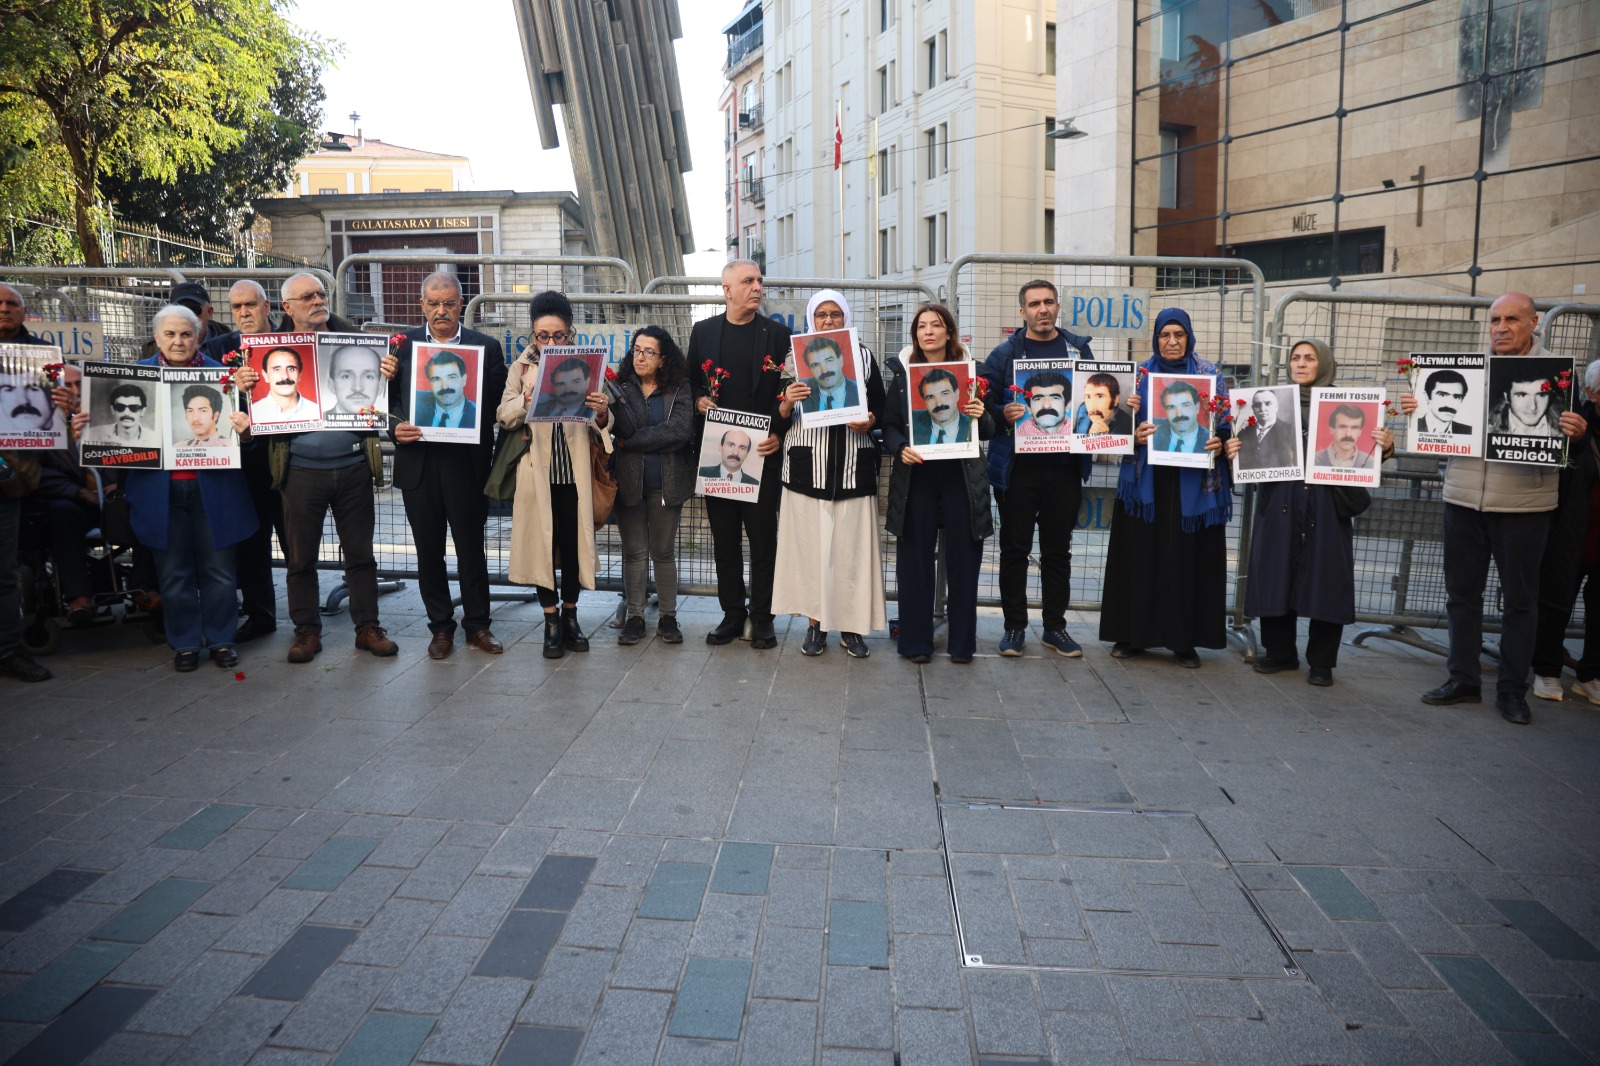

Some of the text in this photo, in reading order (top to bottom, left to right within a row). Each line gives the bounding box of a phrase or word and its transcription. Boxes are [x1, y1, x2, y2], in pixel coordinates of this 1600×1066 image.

[352, 217, 470, 230] GALATASARAY LİSESİ
[1292, 212, 1318, 232] MÜZE
[1071, 293, 1144, 330] POLİS
[242, 333, 315, 345] KENAN BİLGİN
[321, 337, 355, 345] ABDULKADİR
[25, 349, 53, 359] KURT
[543, 347, 575, 355] HÜSEYİN
[1015, 361, 1050, 370] İBRAHİM
[1412, 356, 1484, 366] SÜLEYMAN CİHAN
[86, 365, 161, 378] HAYRETTİN EREN
[1099, 363, 1131, 372] KIRBAYIR
[164, 371, 201, 381] MURAT
[1319, 392, 1347, 400] FEHMİ
[708, 409, 769, 430] RIDVAN KARAKOÇ
[0, 437, 54, 447] KAYBEDİLDİ
[1491, 436, 1562, 449] NURETTİN
[84, 448, 133, 458] GÖZALTINDA
[1417, 443, 1471, 454] KAYBEDİLDİ
[175, 456, 231, 467] KAYBEDİLDİ
[1495, 449, 1556, 463] YEDİGÖL
[1236, 468, 1302, 481] KRİKOR ZOHRAB
[1313, 472, 1374, 483] GÖZALTINDA KAYBEDİLDİ
[705, 484, 755, 494] KAYBEDİLDİ
